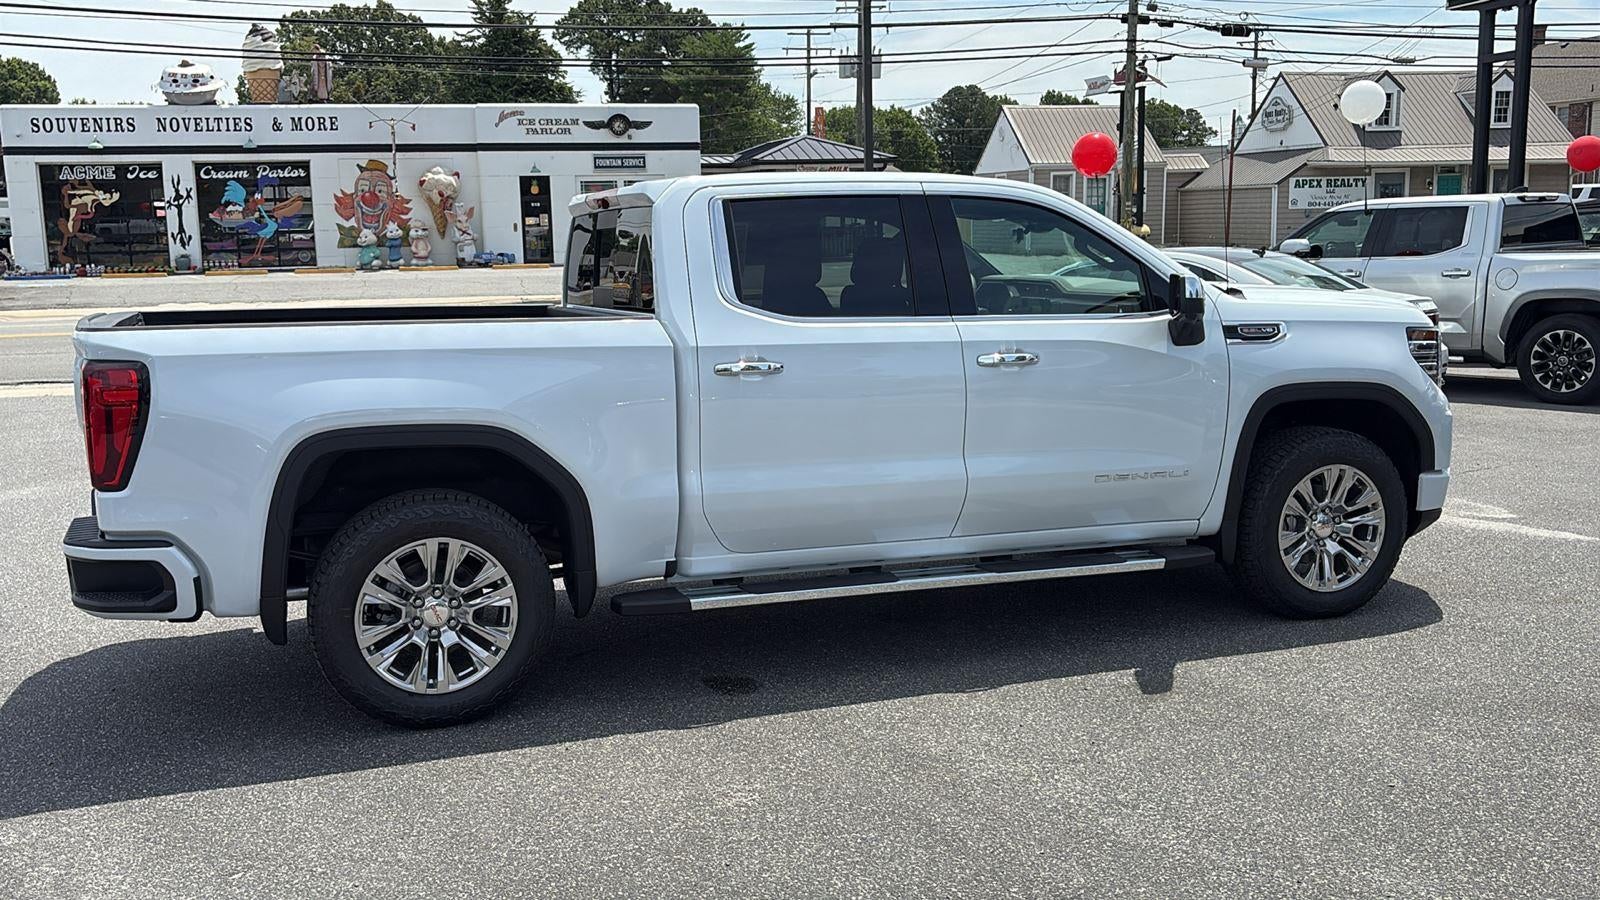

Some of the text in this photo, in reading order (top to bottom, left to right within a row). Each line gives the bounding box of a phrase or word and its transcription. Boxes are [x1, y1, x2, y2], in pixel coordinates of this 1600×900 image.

[30, 116, 339, 133] SOUVENIRS NOVELTIES & MORE
[517, 118, 580, 126] ICE CREAM
[525, 127, 572, 135] PARLOR
[595, 158, 645, 168] FOUNTAIN SERVICE
[59, 165, 159, 180] ACME Ice
[200, 164, 307, 179] Cream Parlor
[1294, 177, 1367, 188] APEX REALTY
[1094, 469, 1190, 483] DENALI
